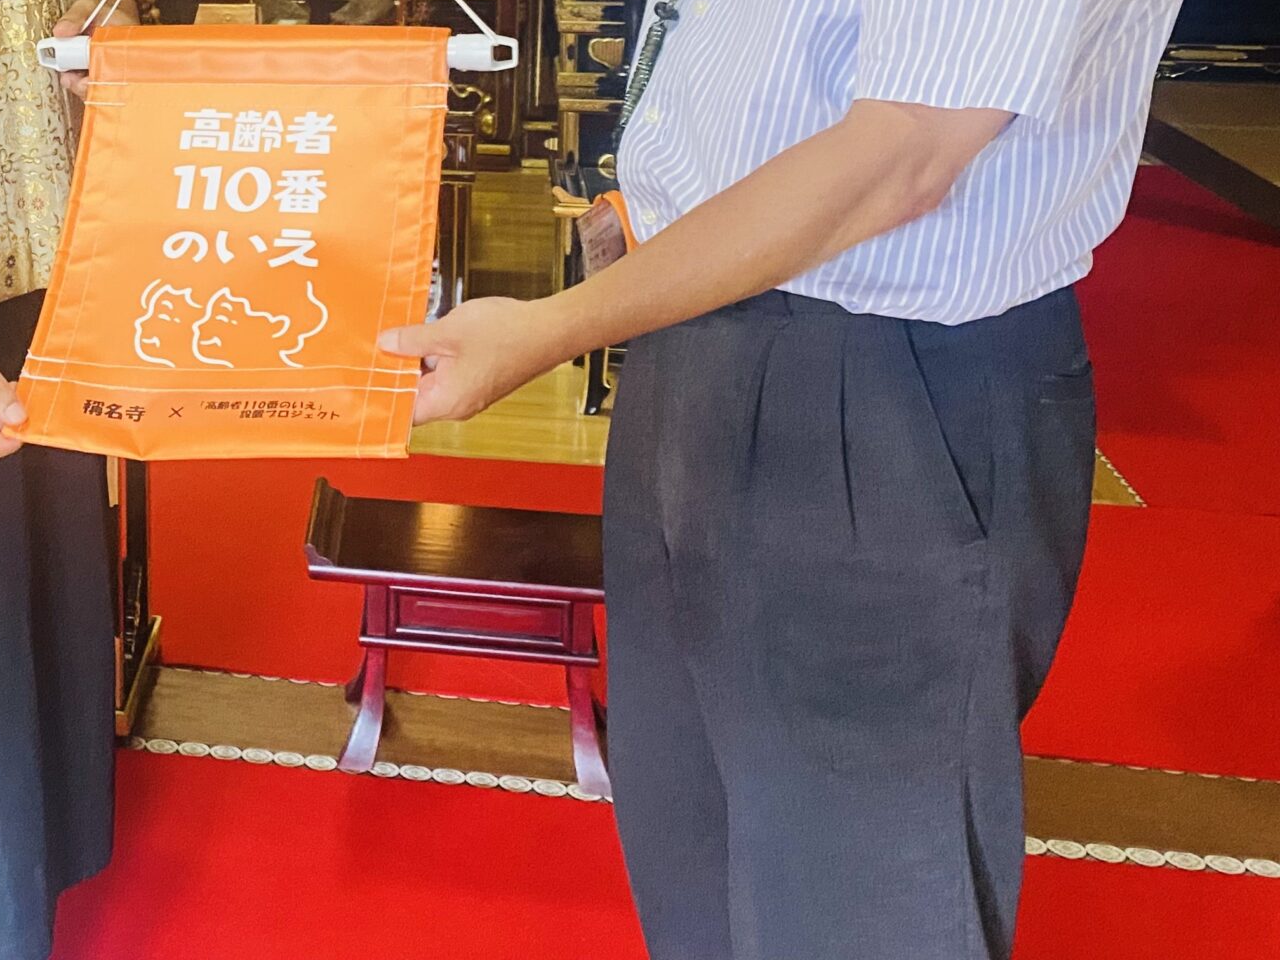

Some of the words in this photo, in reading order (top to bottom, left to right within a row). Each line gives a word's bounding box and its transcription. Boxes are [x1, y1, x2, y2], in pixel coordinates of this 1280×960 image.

[179, 107, 338, 155] 高齢者
[173, 164, 327, 214] 110番
[162, 228, 319, 268] のいえ
